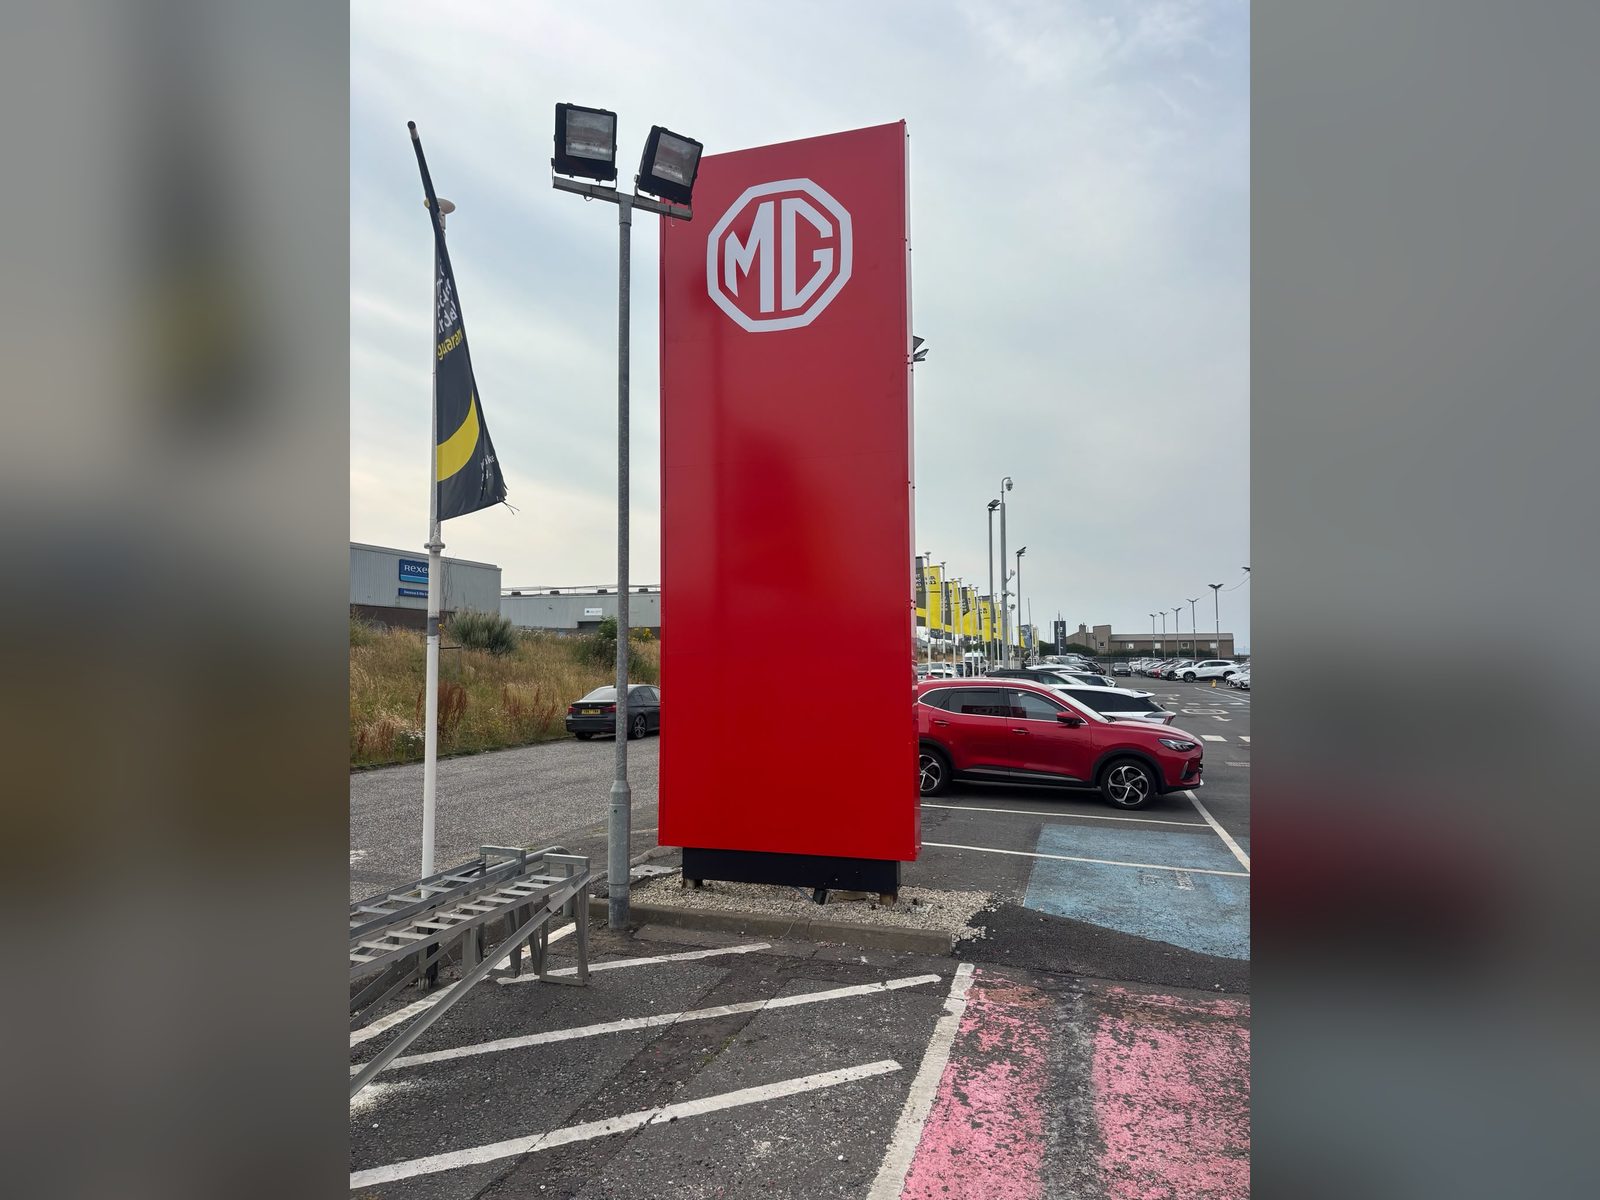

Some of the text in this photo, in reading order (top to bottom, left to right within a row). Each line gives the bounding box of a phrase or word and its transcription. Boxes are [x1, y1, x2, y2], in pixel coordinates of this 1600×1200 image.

[724, 197, 834, 313] MG
[437, 327, 464, 360] guaran
[404, 564, 428, 574] Rexe
